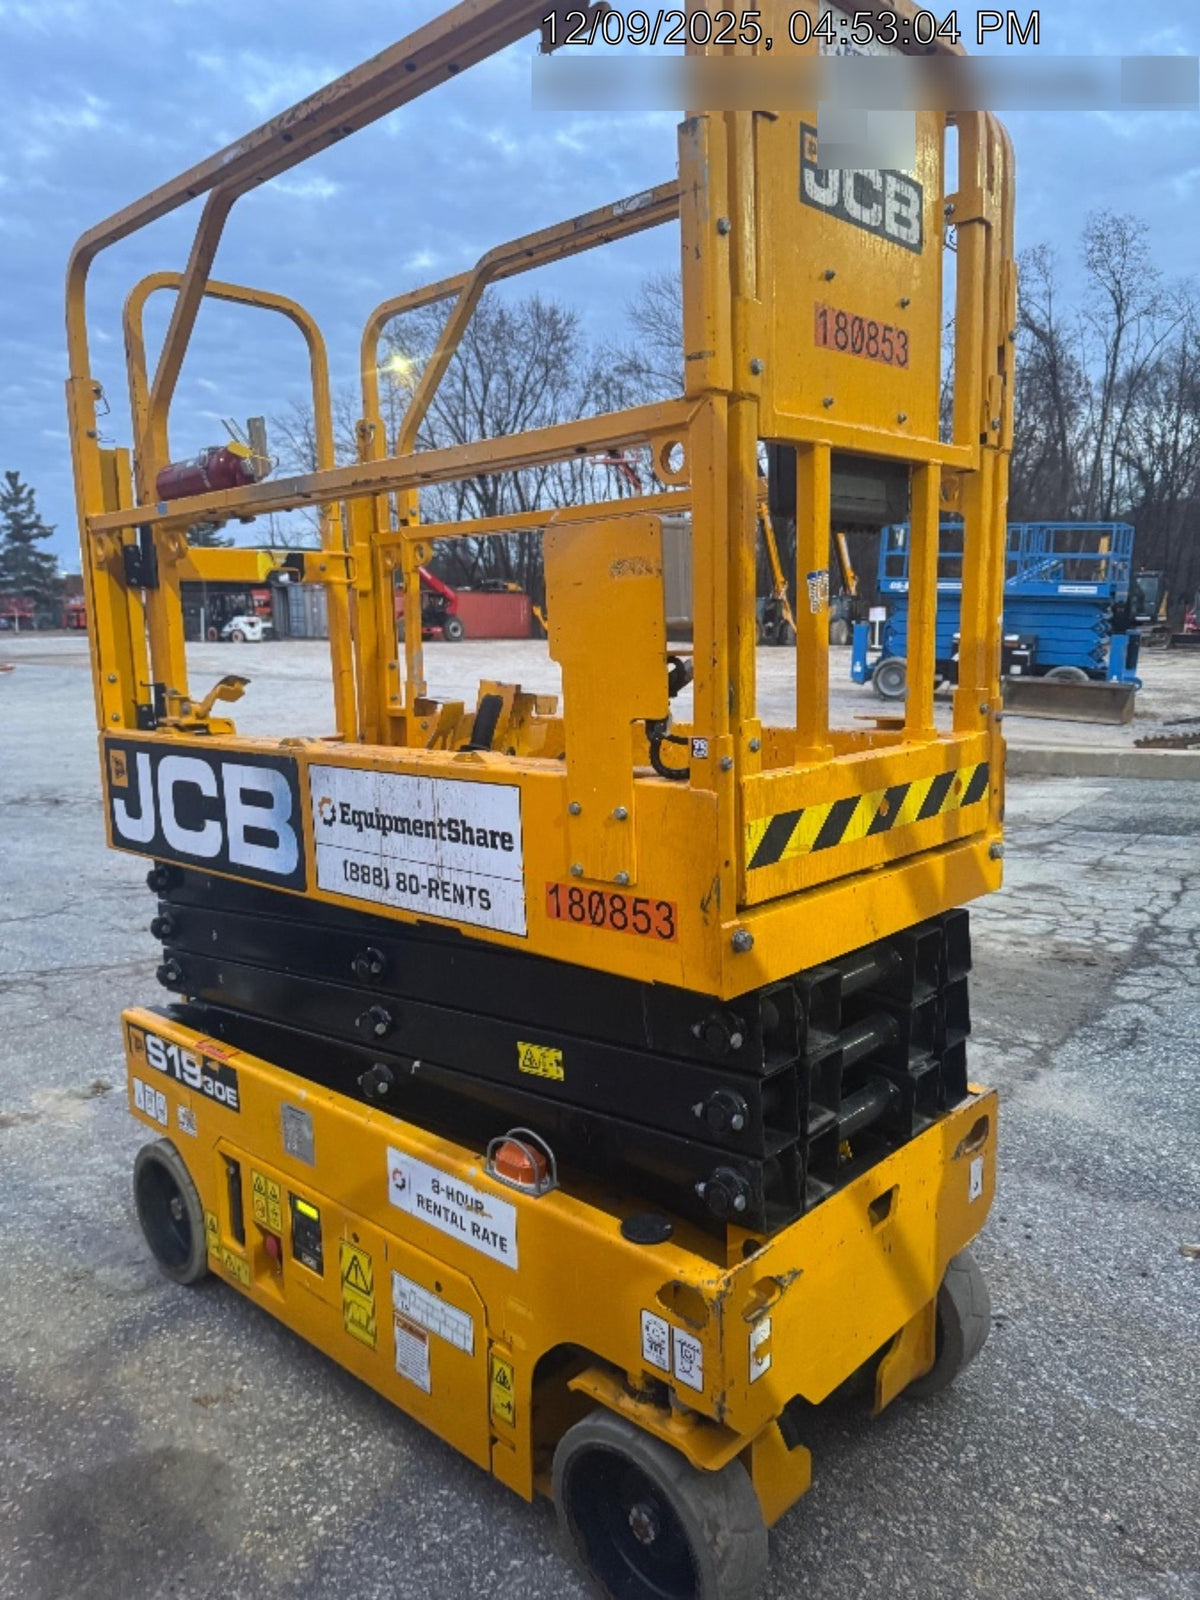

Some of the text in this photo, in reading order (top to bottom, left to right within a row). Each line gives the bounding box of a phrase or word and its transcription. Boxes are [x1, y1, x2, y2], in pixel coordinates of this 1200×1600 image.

[819, 308, 908, 367] 180853
[113, 751, 299, 876] JCB
[339, 802, 515, 852] EquipmentShare
[343, 859, 492, 911] (888) 80-RENTS
[549, 883, 675, 939] 180853
[416, 1193, 508, 1254] RENTAL RATE
[431, 1178, 485, 1213] 8-HOUR
